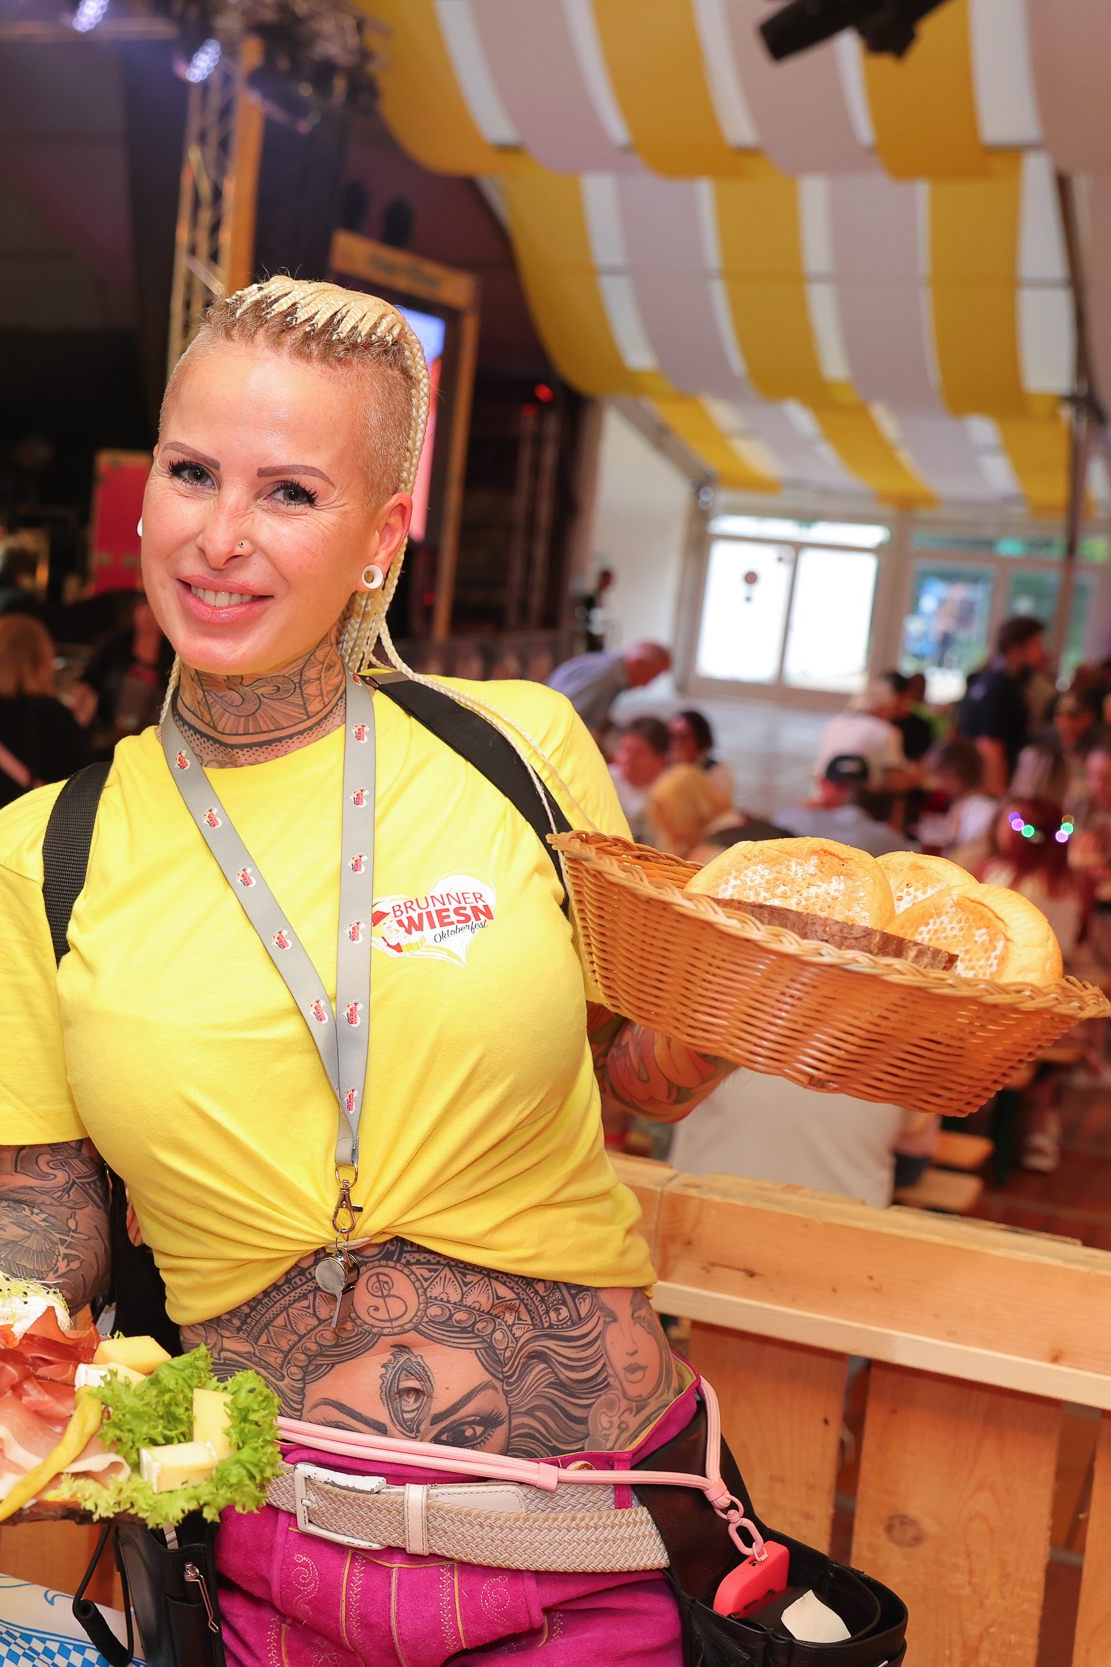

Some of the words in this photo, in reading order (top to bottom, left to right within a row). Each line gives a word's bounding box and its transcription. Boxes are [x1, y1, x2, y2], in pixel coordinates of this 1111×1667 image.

[391, 891, 486, 918] BRUNNER
[396, 904, 494, 936] WIESN
[433, 918, 488, 944] Oktoberfest
